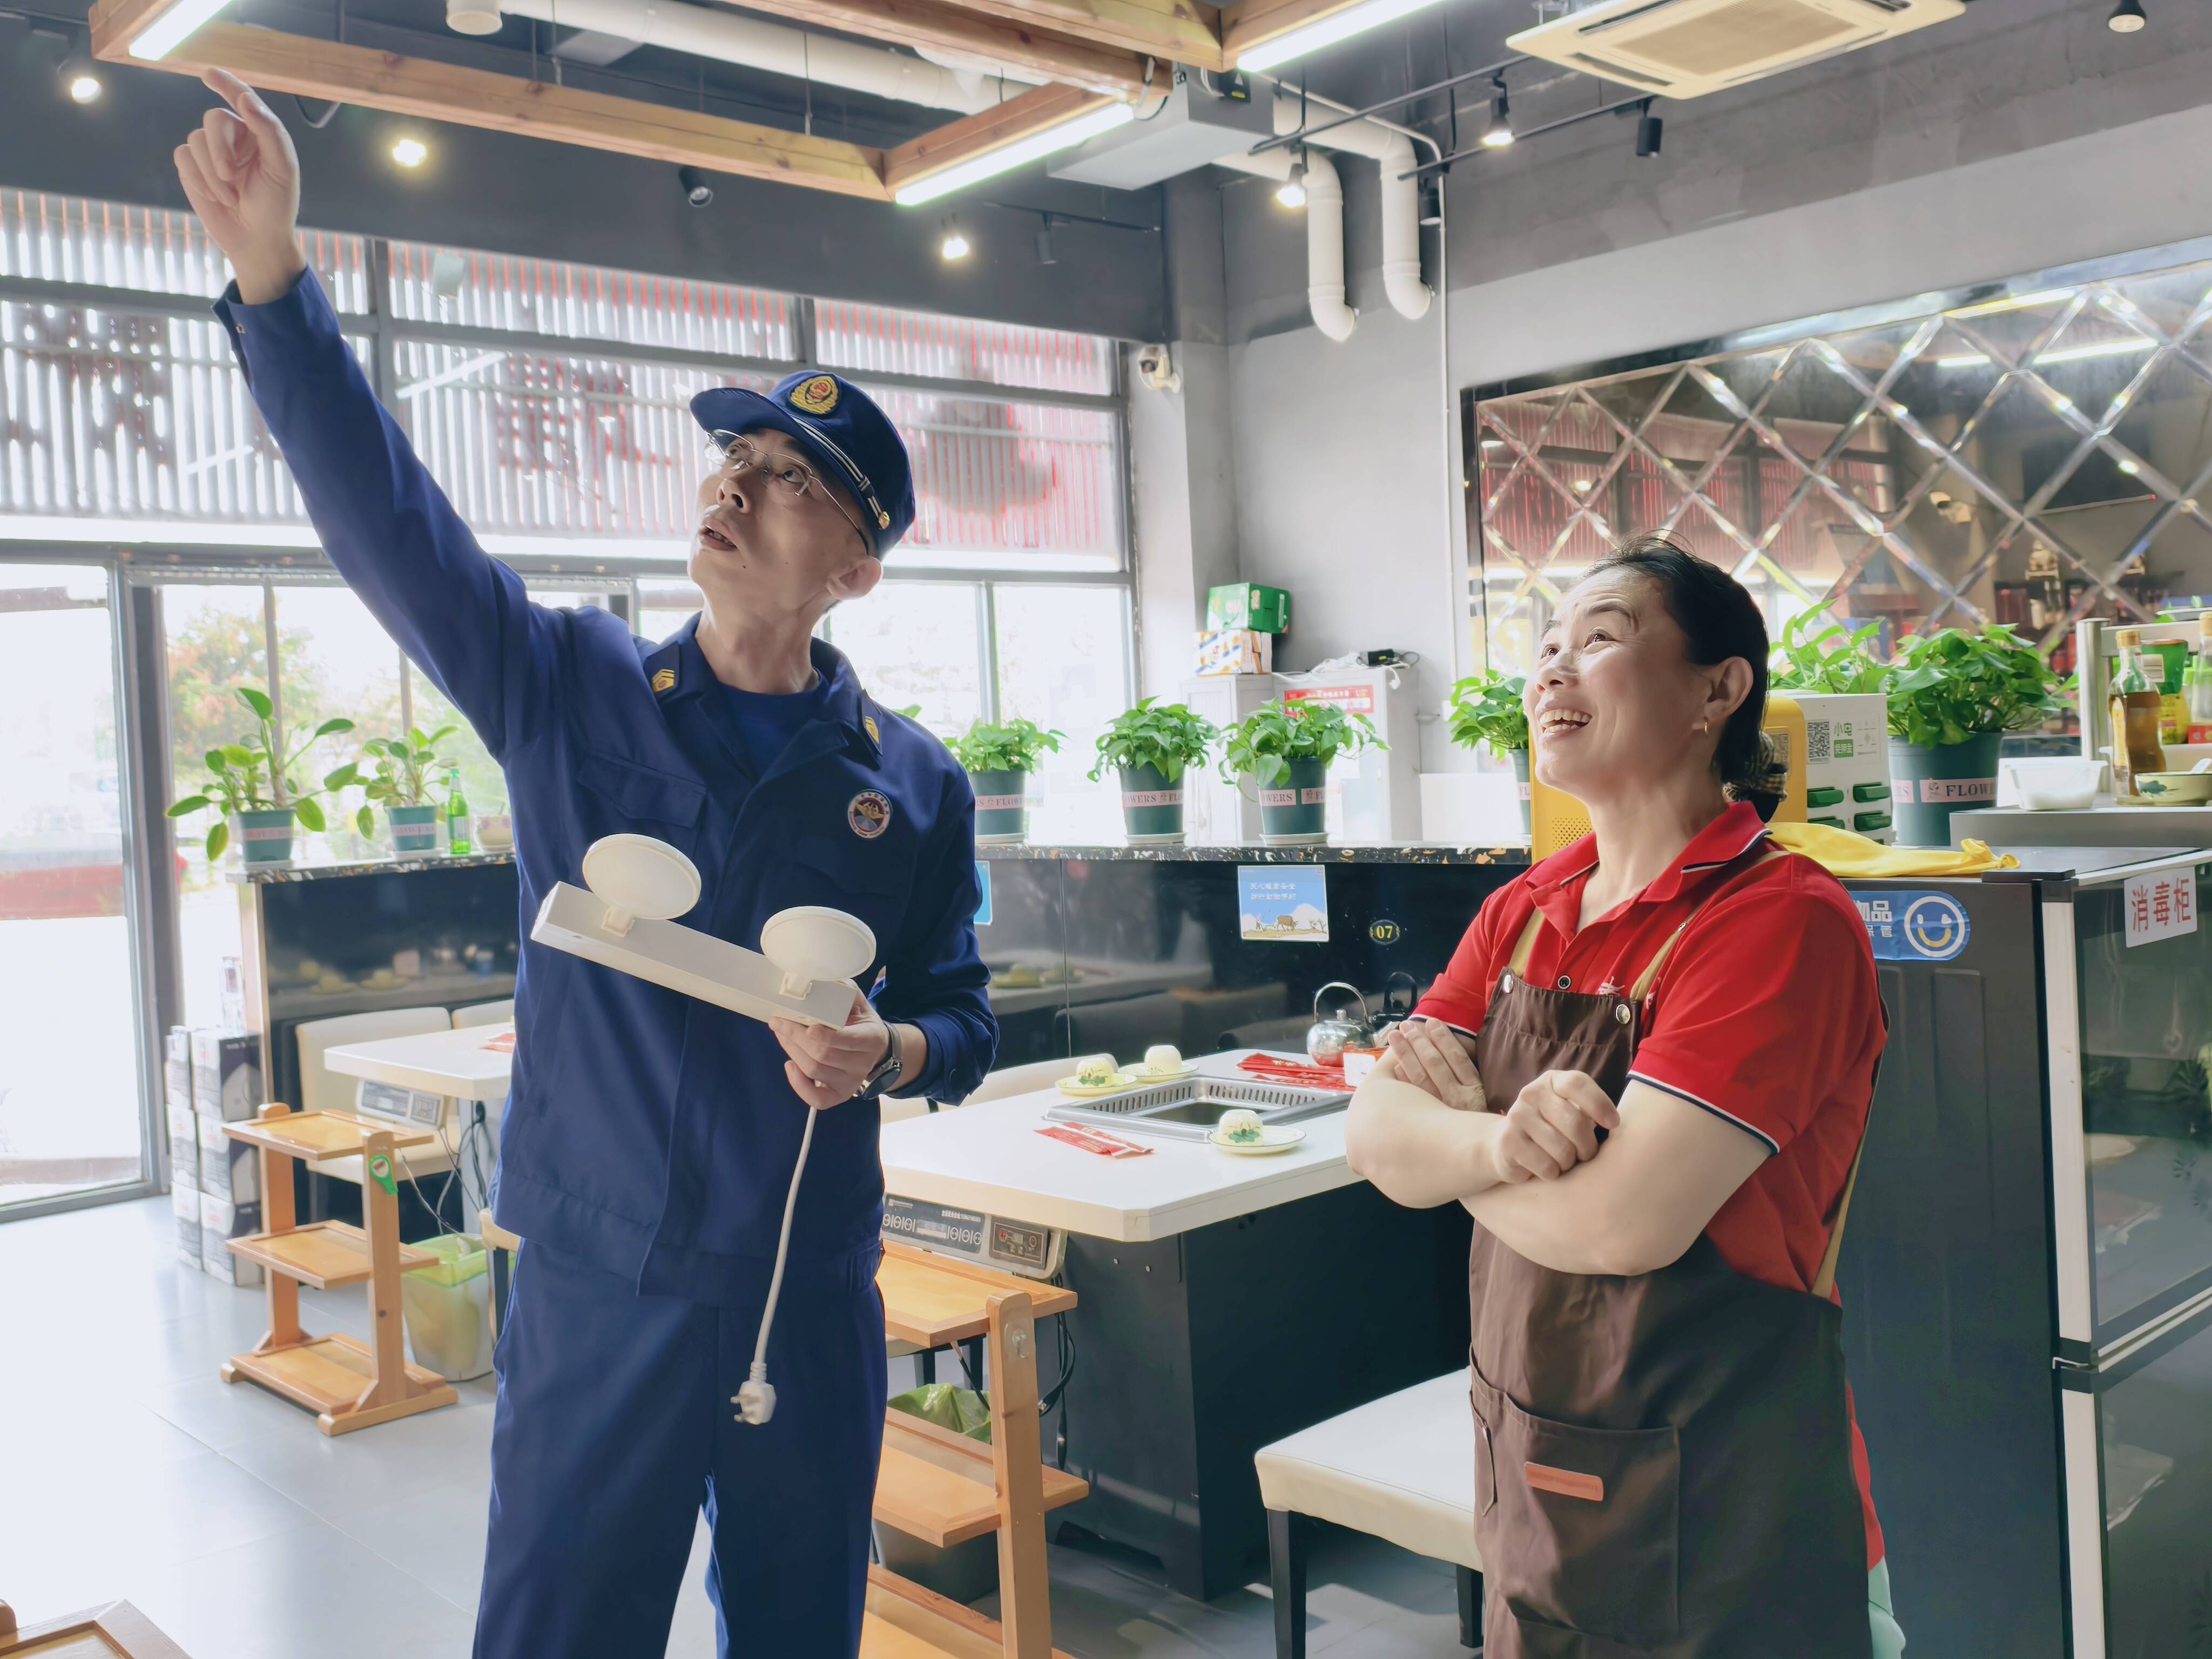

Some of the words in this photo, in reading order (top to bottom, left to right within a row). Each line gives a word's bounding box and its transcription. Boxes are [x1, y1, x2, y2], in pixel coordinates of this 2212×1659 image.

[2131, 878, 2191, 933] 消毒柜
[1376, 925, 1393, 939] 07
